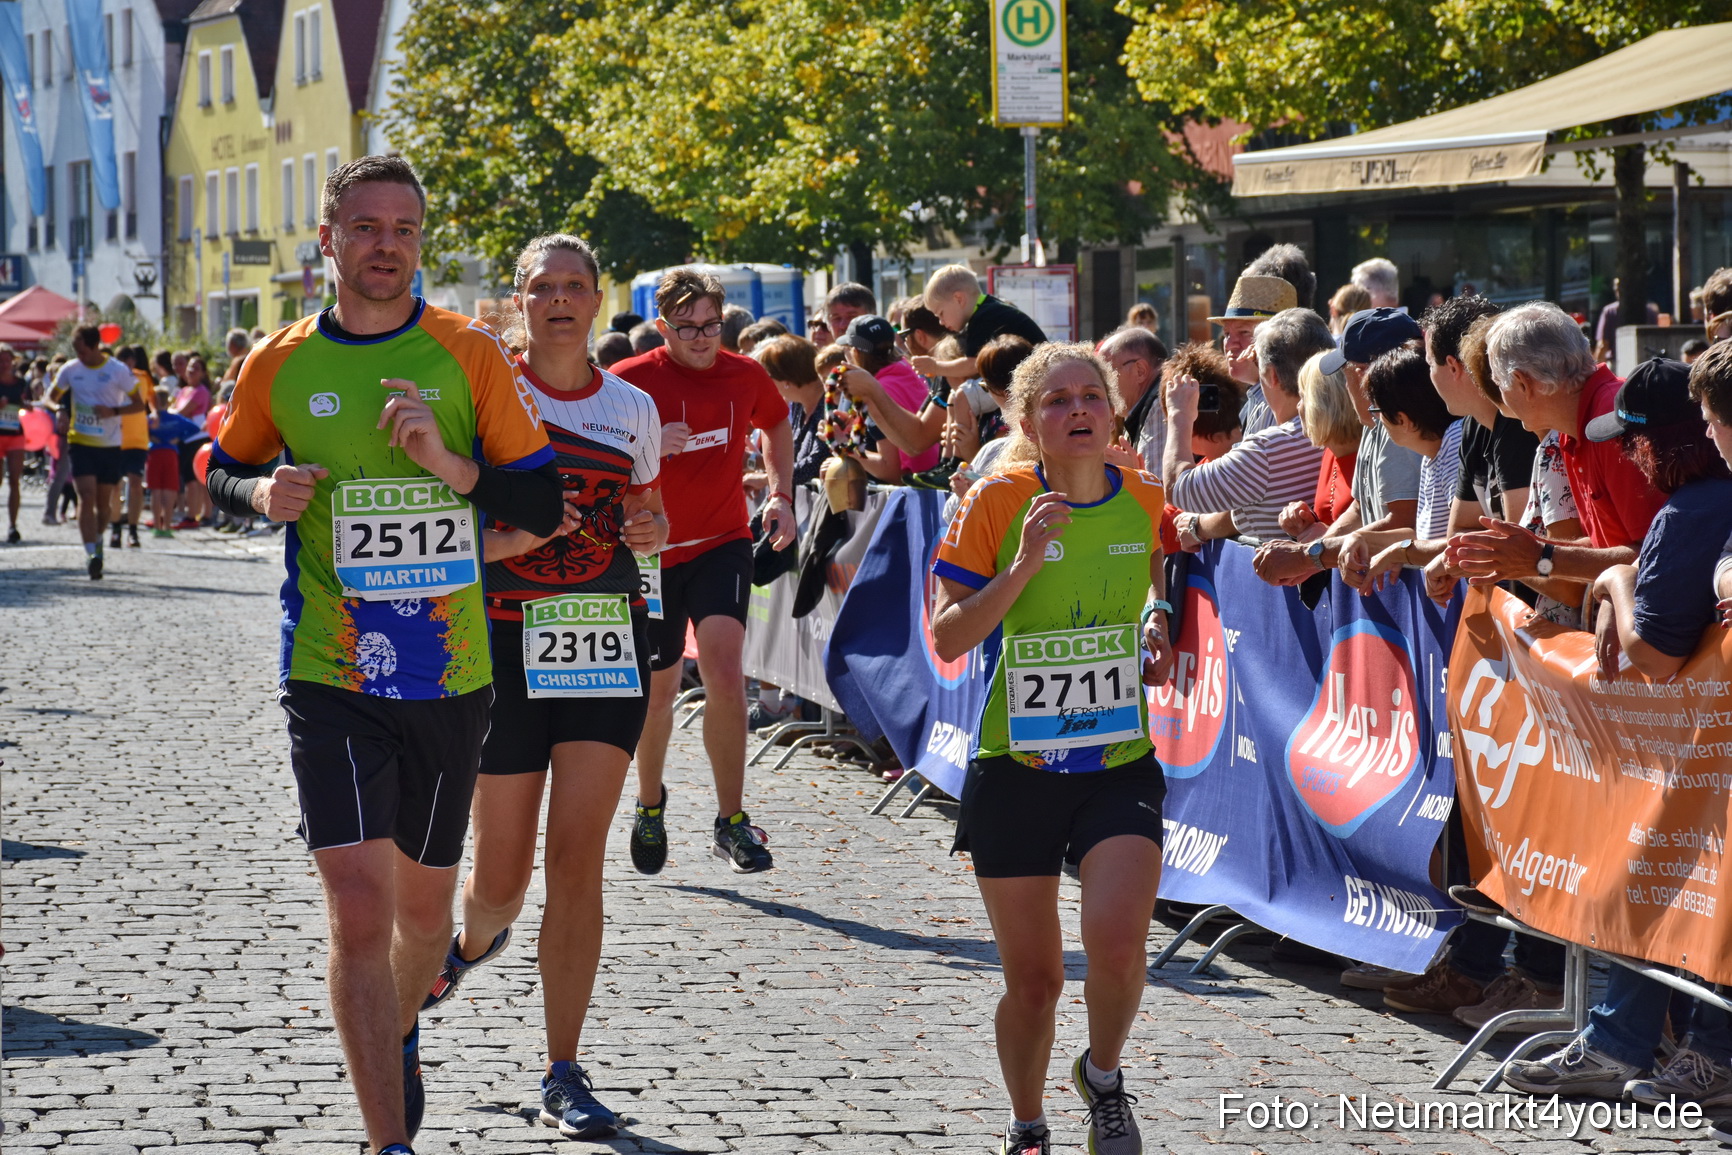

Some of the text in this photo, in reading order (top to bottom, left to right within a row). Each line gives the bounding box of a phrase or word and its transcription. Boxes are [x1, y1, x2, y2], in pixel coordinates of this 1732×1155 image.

[1007, 53, 1051, 63] Marktplatz
[389, 389, 441, 400] CK
[582, 422, 630, 439] NEUMARKT
[695, 435, 716, 446] DEHN
[343, 482, 461, 512] BOCK
[350, 518, 457, 559] 2512
[1108, 542, 1146, 555] BOCK
[365, 567, 447, 587] MARTIN
[532, 599, 624, 625] BOCK
[538, 631, 622, 663] 2319
[1014, 629, 1127, 664] BOCK
[537, 672, 630, 687] CHRISTINA
[1023, 666, 1121, 709] 2711
[1057, 705, 1116, 722] KERSTIN
[1298, 670, 1414, 789] Hervis
[1301, 766, 1345, 797] SPORTS
[1647, 827, 1669, 848] Sie
[1671, 826, 1698, 849] sich
[1509, 837, 1588, 896] Agentur
[1627, 855, 1718, 886] web: codeclinic.de
[1344, 875, 1375, 928] GET
[1626, 884, 1650, 905] tel:
[1650, 885, 1683, 909] 09181
[1683, 890, 1706, 915] 8833
